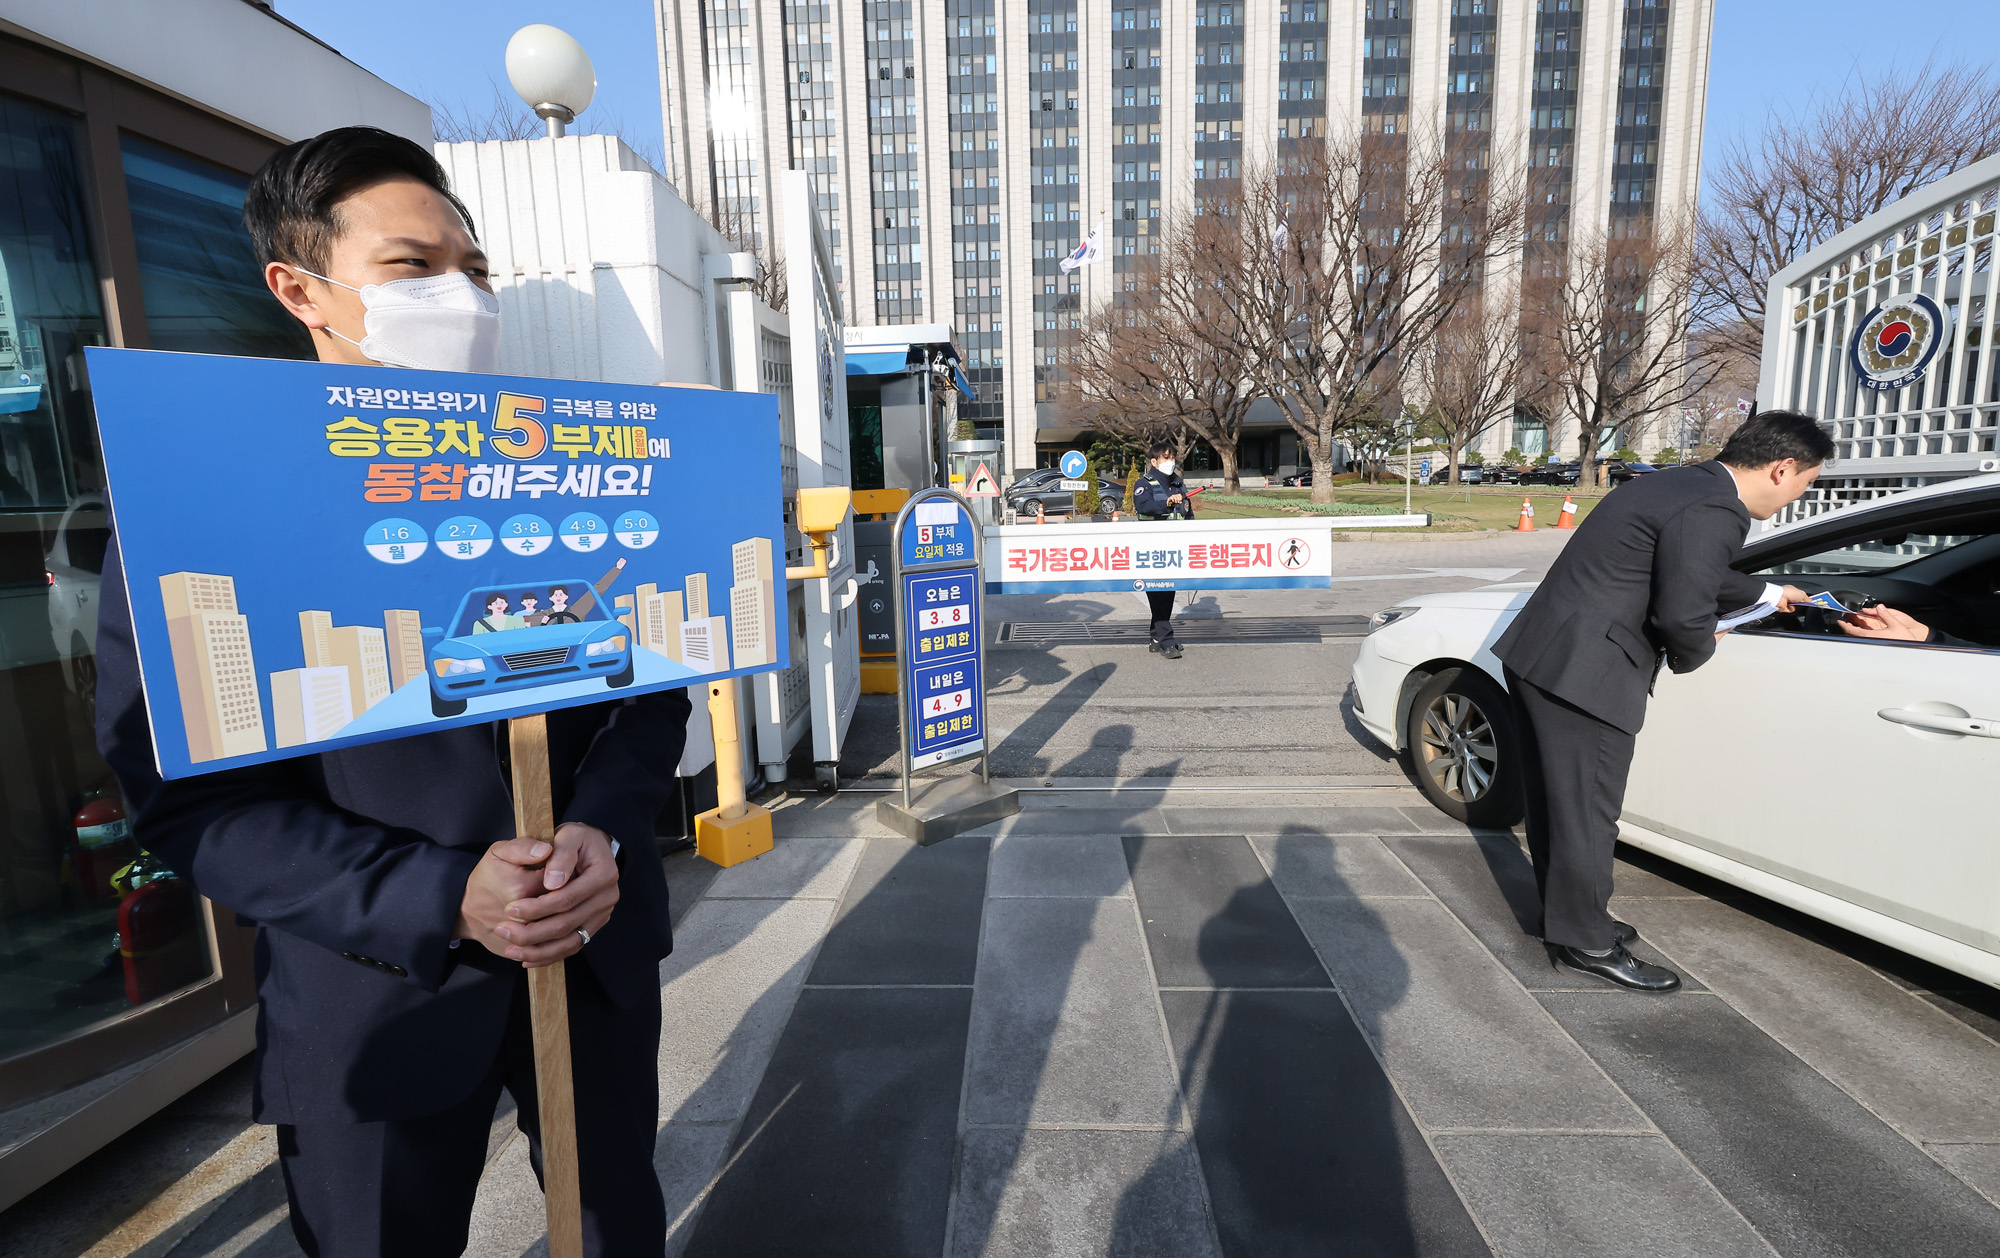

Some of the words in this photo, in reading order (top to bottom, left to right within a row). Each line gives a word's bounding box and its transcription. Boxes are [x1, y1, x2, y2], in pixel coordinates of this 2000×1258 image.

[1867, 373, 1916, 390] 대한민국
[326, 386, 487, 413] 자원안보위기
[552, 398, 614, 419] 극복을
[619, 401, 658, 420] 위한
[325, 416, 485, 458] 승용차
[490, 390, 549, 461] 5
[648, 438, 671, 459] 에
[364, 463, 653, 503] 동참해주세요!
[578, 536, 592, 548] 목
[631, 533, 644, 546] 금
[921, 528, 930, 542] 5
[936, 525, 955, 539] 부제
[389, 545, 405, 560] 월
[457, 542, 474, 555] 화
[520, 539, 535, 552] 수
[914, 544, 944, 559] 요일제
[945, 542, 965, 556] 적용
[1008, 546, 1130, 573] 국가중요시설
[1135, 550, 1183, 569] 보행자
[1188, 543, 1272, 569] 통행금지
[926, 585, 961, 603] 오늘은
[952, 608, 961, 622] 8
[920, 631, 970, 653] 출입제한
[929, 670, 964, 690] 내일은
[954, 693, 962, 707] 9
[924, 714, 973, 740] 출입제한
